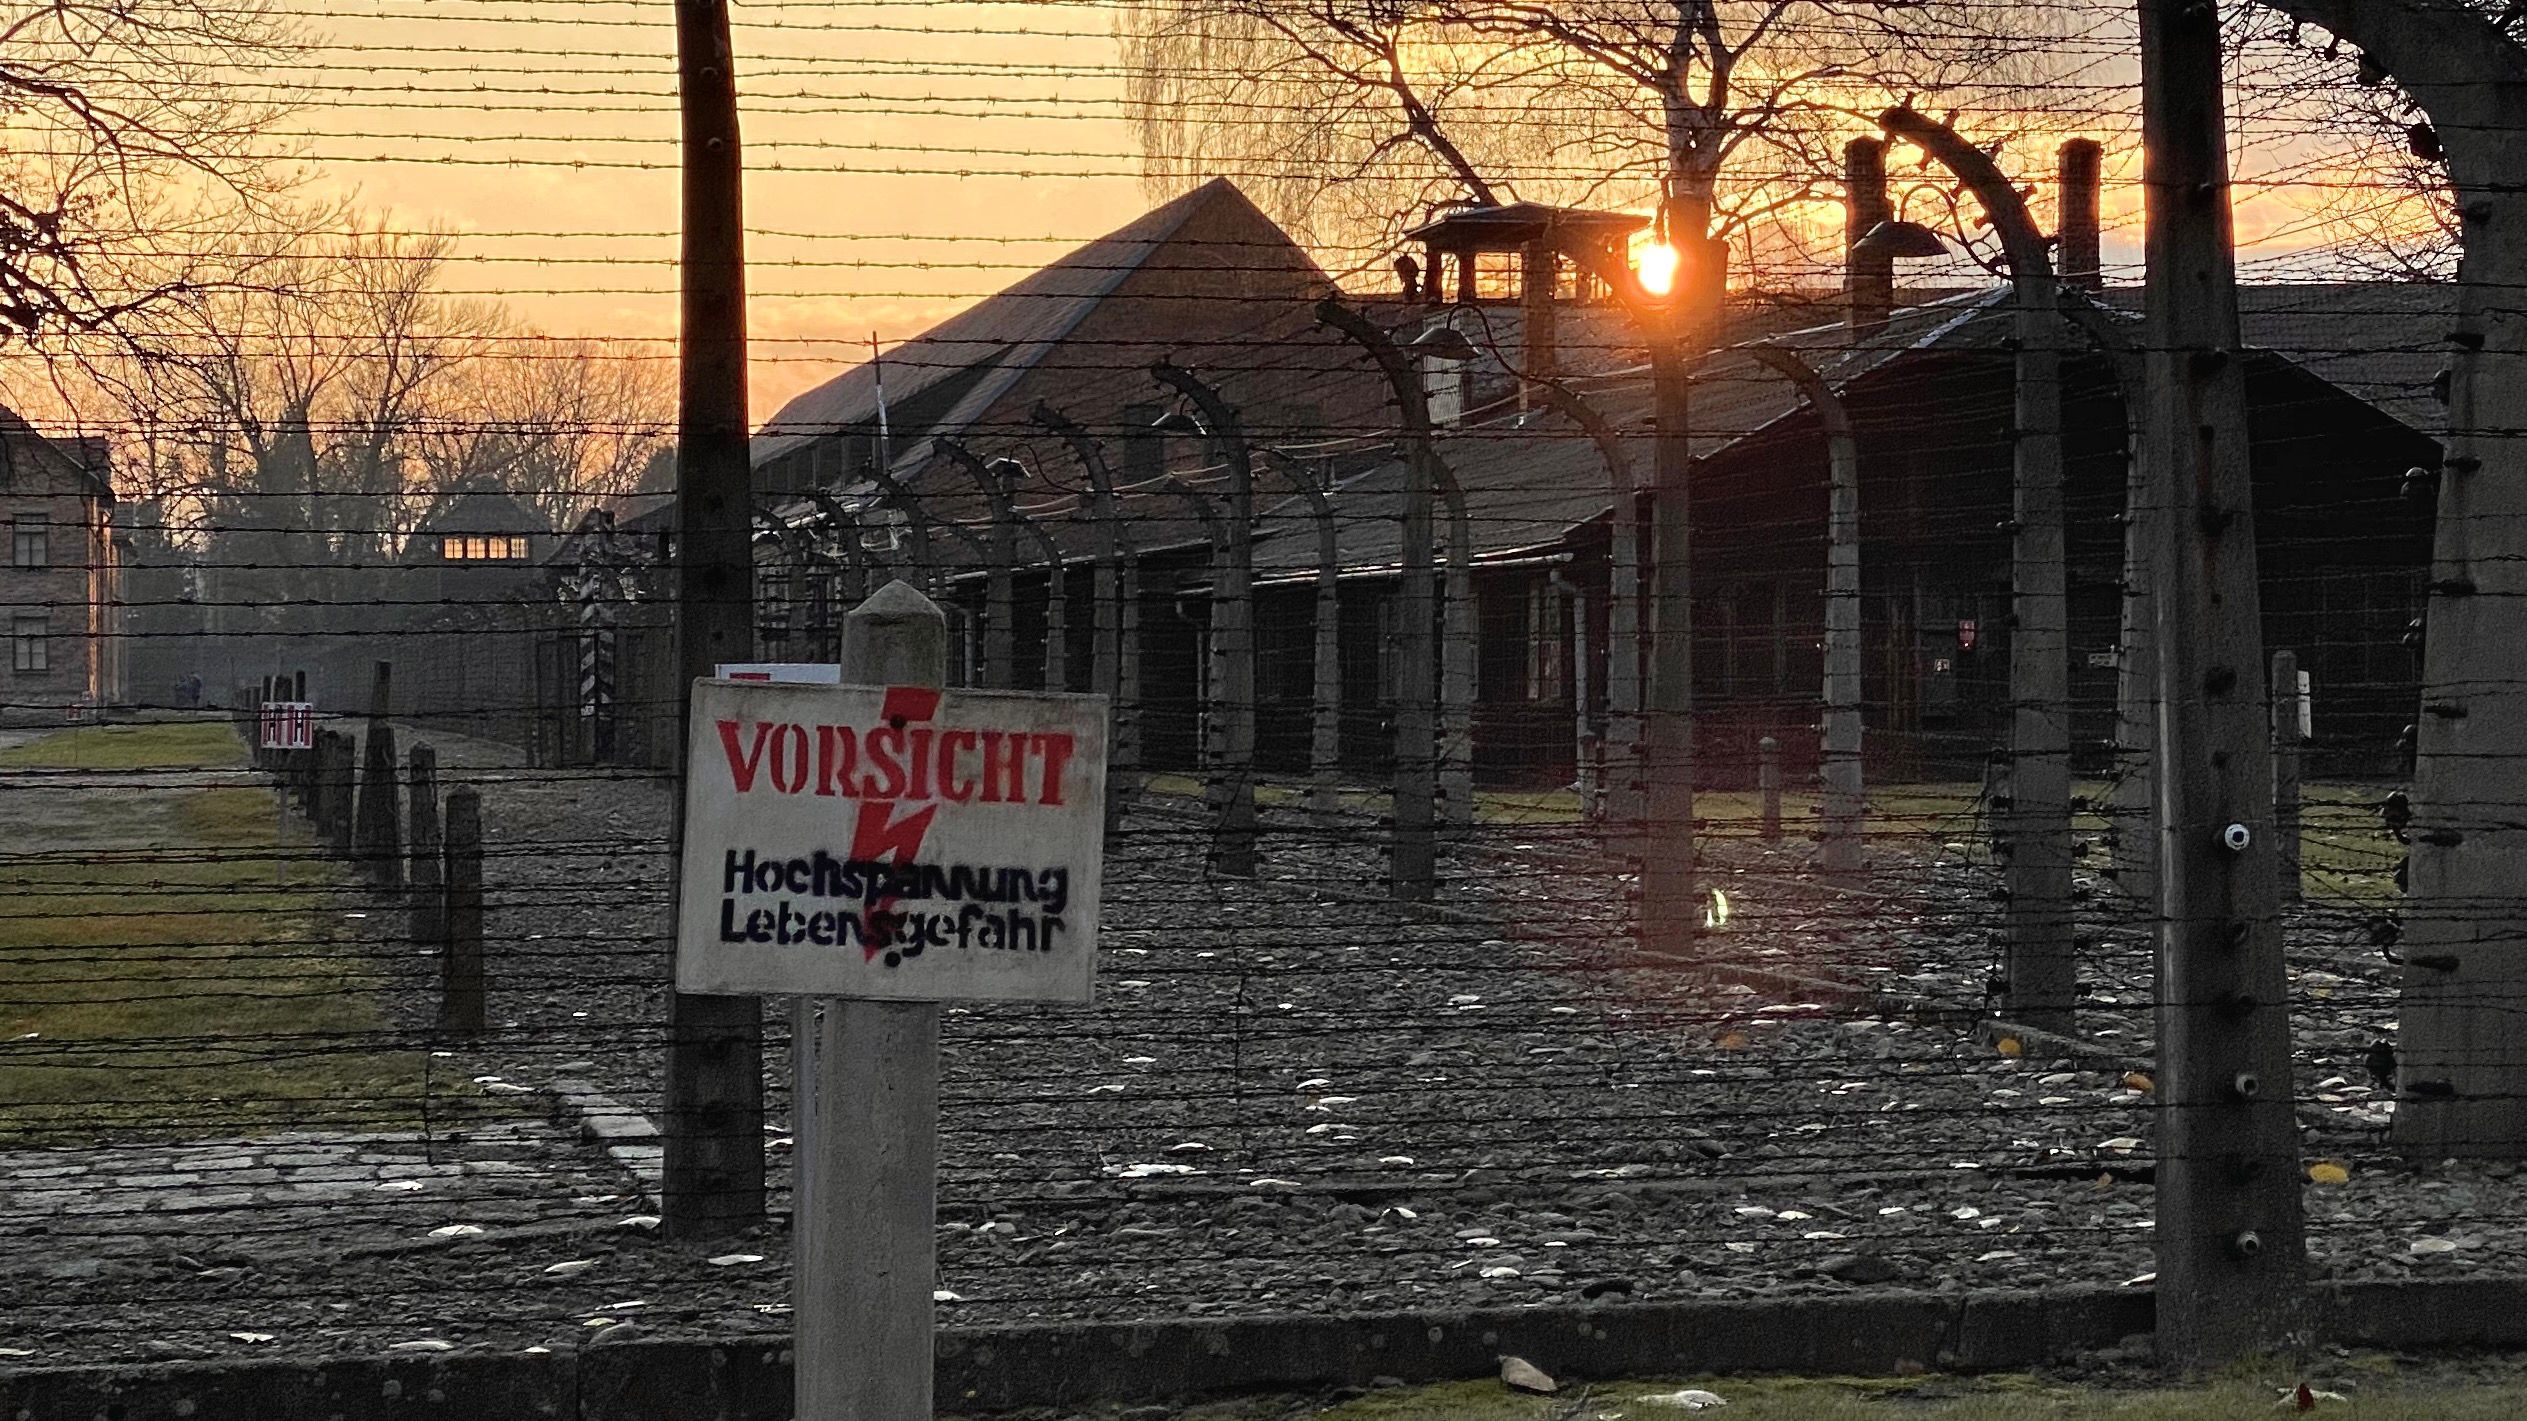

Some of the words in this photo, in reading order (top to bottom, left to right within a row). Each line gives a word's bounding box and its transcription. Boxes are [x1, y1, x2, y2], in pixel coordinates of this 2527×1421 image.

[717, 720, 1073, 805] VORSICHT
[724, 849, 1068, 912] Hochspannung
[720, 899, 1065, 956] Lebensgefahr
